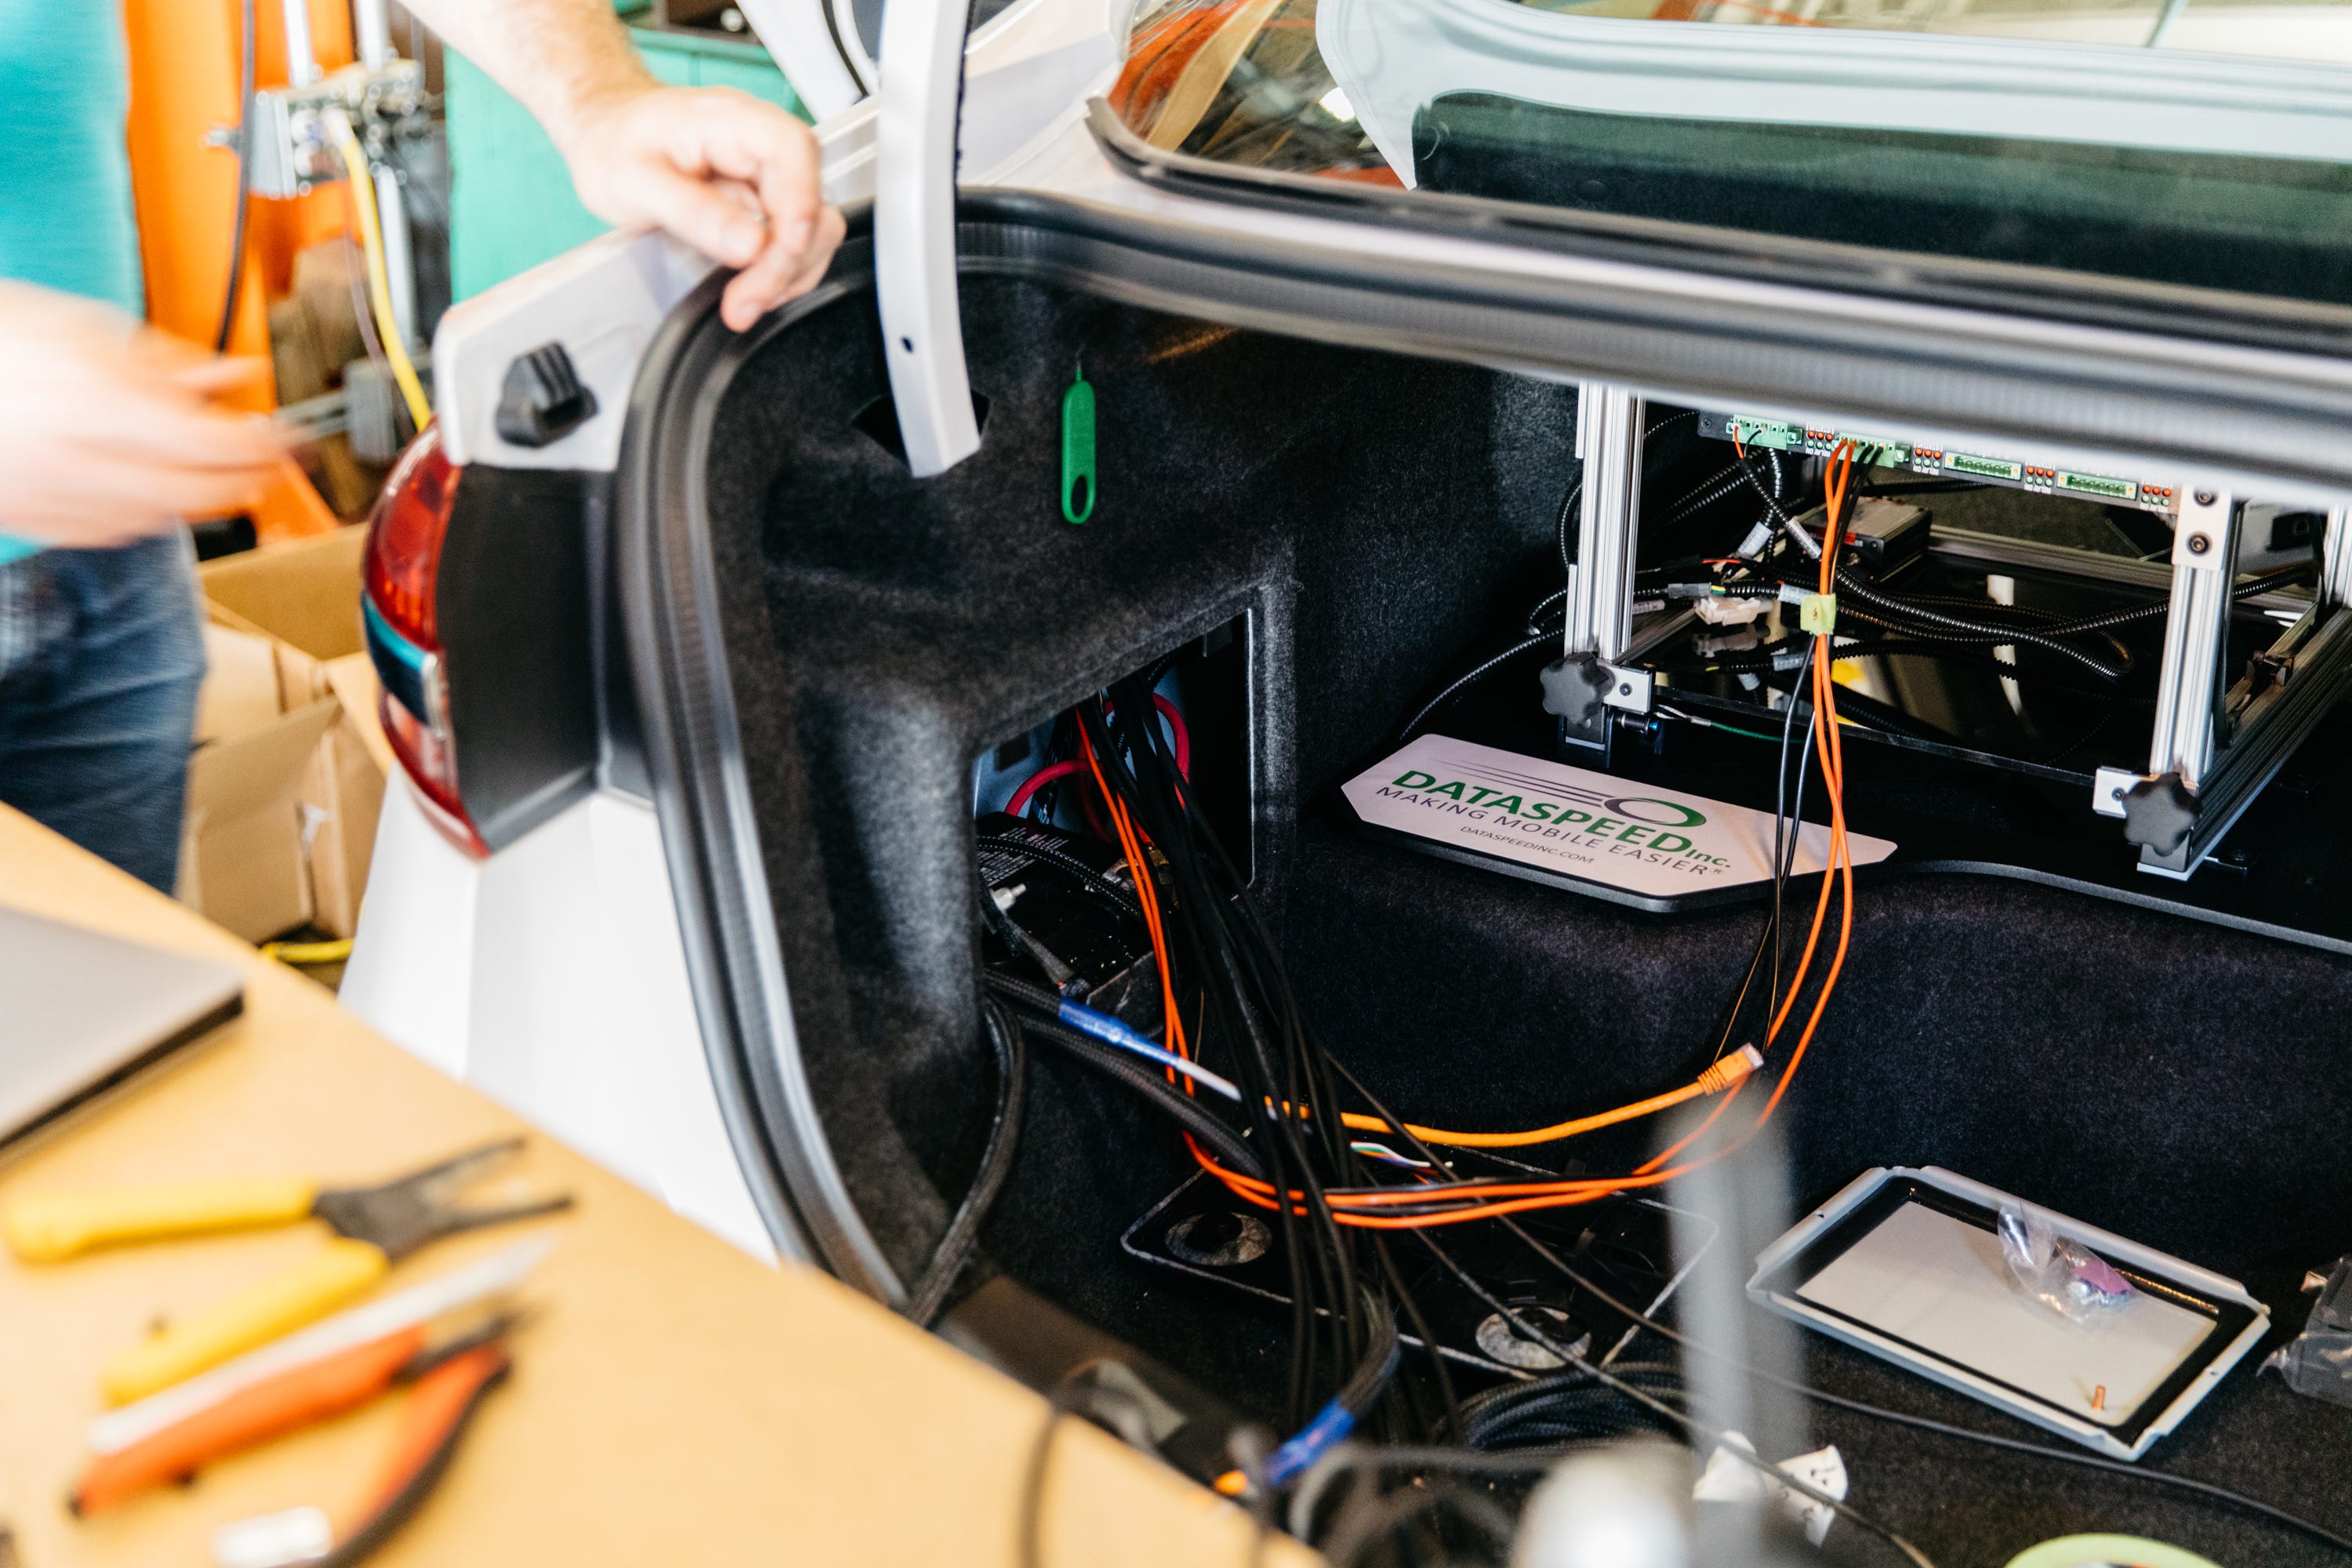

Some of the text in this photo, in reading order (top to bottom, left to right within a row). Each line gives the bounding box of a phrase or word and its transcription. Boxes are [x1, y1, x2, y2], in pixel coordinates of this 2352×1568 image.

[1376, 787, 1489, 820] MAKING
[1493, 815, 1604, 848] MOBILE
[1460, 826, 1595, 864] DATASPEEDINC.COM
